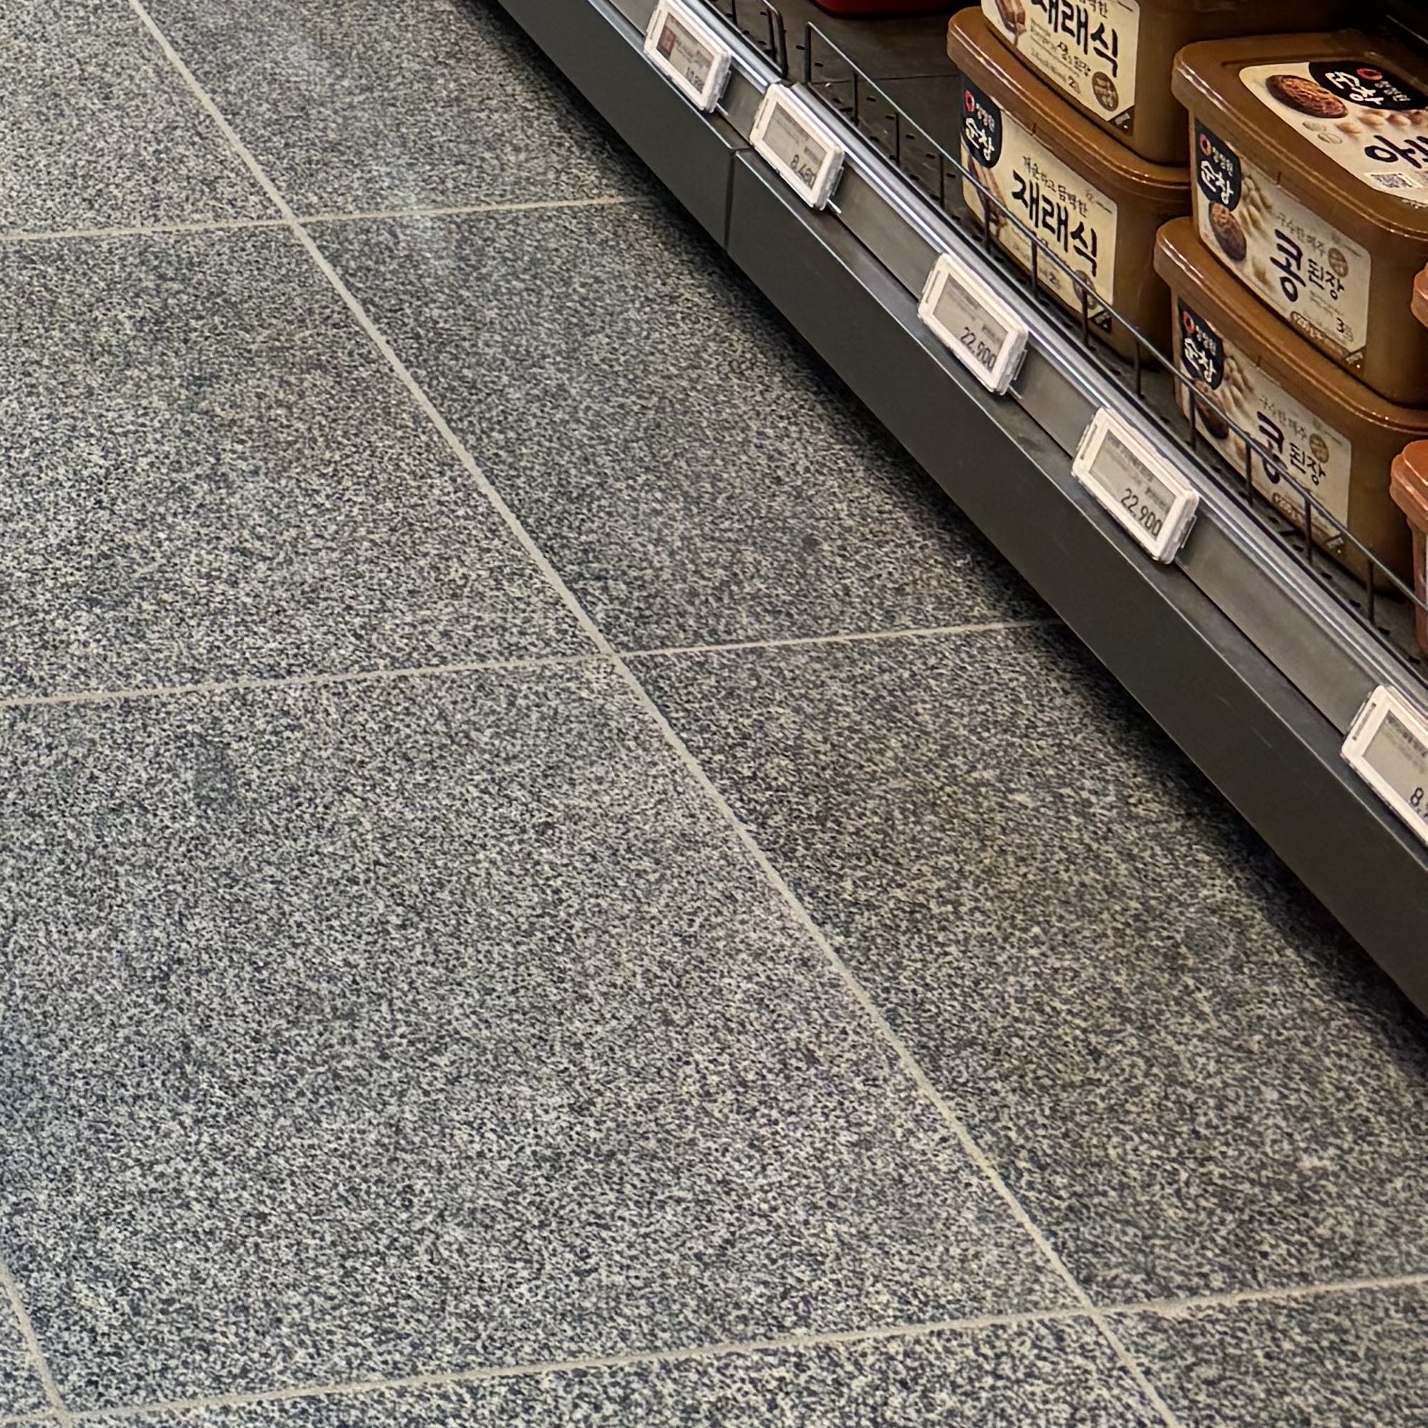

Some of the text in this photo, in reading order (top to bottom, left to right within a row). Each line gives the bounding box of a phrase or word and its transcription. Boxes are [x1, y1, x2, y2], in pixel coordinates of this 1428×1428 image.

[964, 115, 996, 160] 순창
[1199, 158, 1233, 203] 순창
[1011, 169, 1099, 278] 재래식
[1269, 227, 1346, 303] 콩 된장
[957, 326, 998, 370] 22,900
[1183, 336, 1217, 383] 순창
[1288, 442, 1327, 487] 된장
[1120, 487, 1163, 538] 22,900
